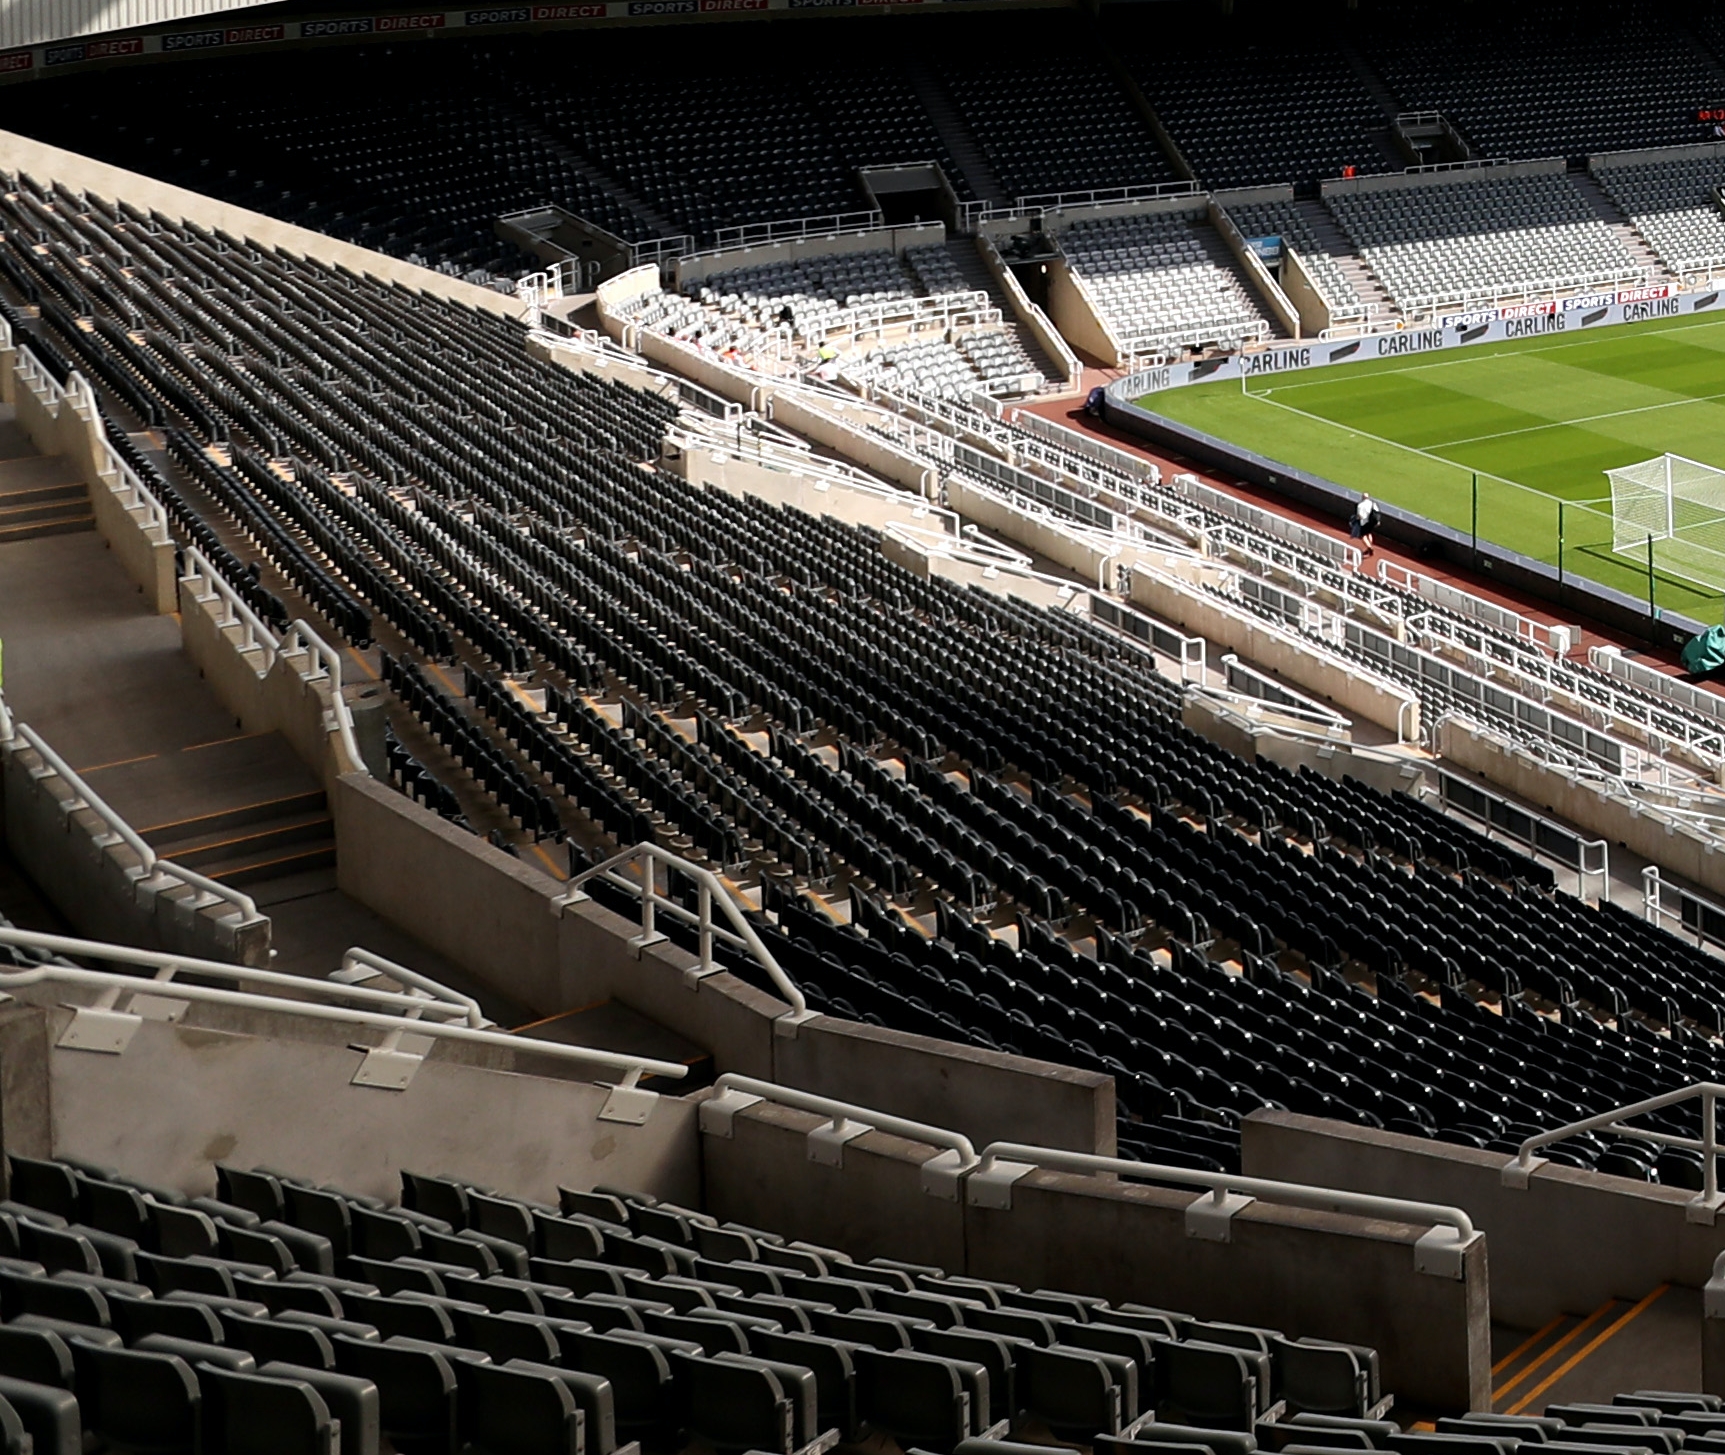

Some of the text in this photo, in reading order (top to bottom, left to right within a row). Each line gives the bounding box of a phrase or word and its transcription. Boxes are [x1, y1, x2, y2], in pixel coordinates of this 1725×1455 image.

[468, 5, 603, 24] SPORTS DIRECT
[631, 2, 696, 15] SPORTS
[166, 26, 281, 49] SPORTS DIRECT
[303, 15, 443, 35] SPORTS DIRECT
[1565, 286, 1667, 311] SPORTS DIRECT
[1623, 297, 1680, 322] CARLING
[1444, 304, 1550, 328] SPORTS DIRECT
[1506, 313, 1566, 338] CARLING
[1378, 330, 1443, 355] CARLING
[1240, 348, 1311, 375] CARLING
[1121, 369, 1170, 401] CARLING
